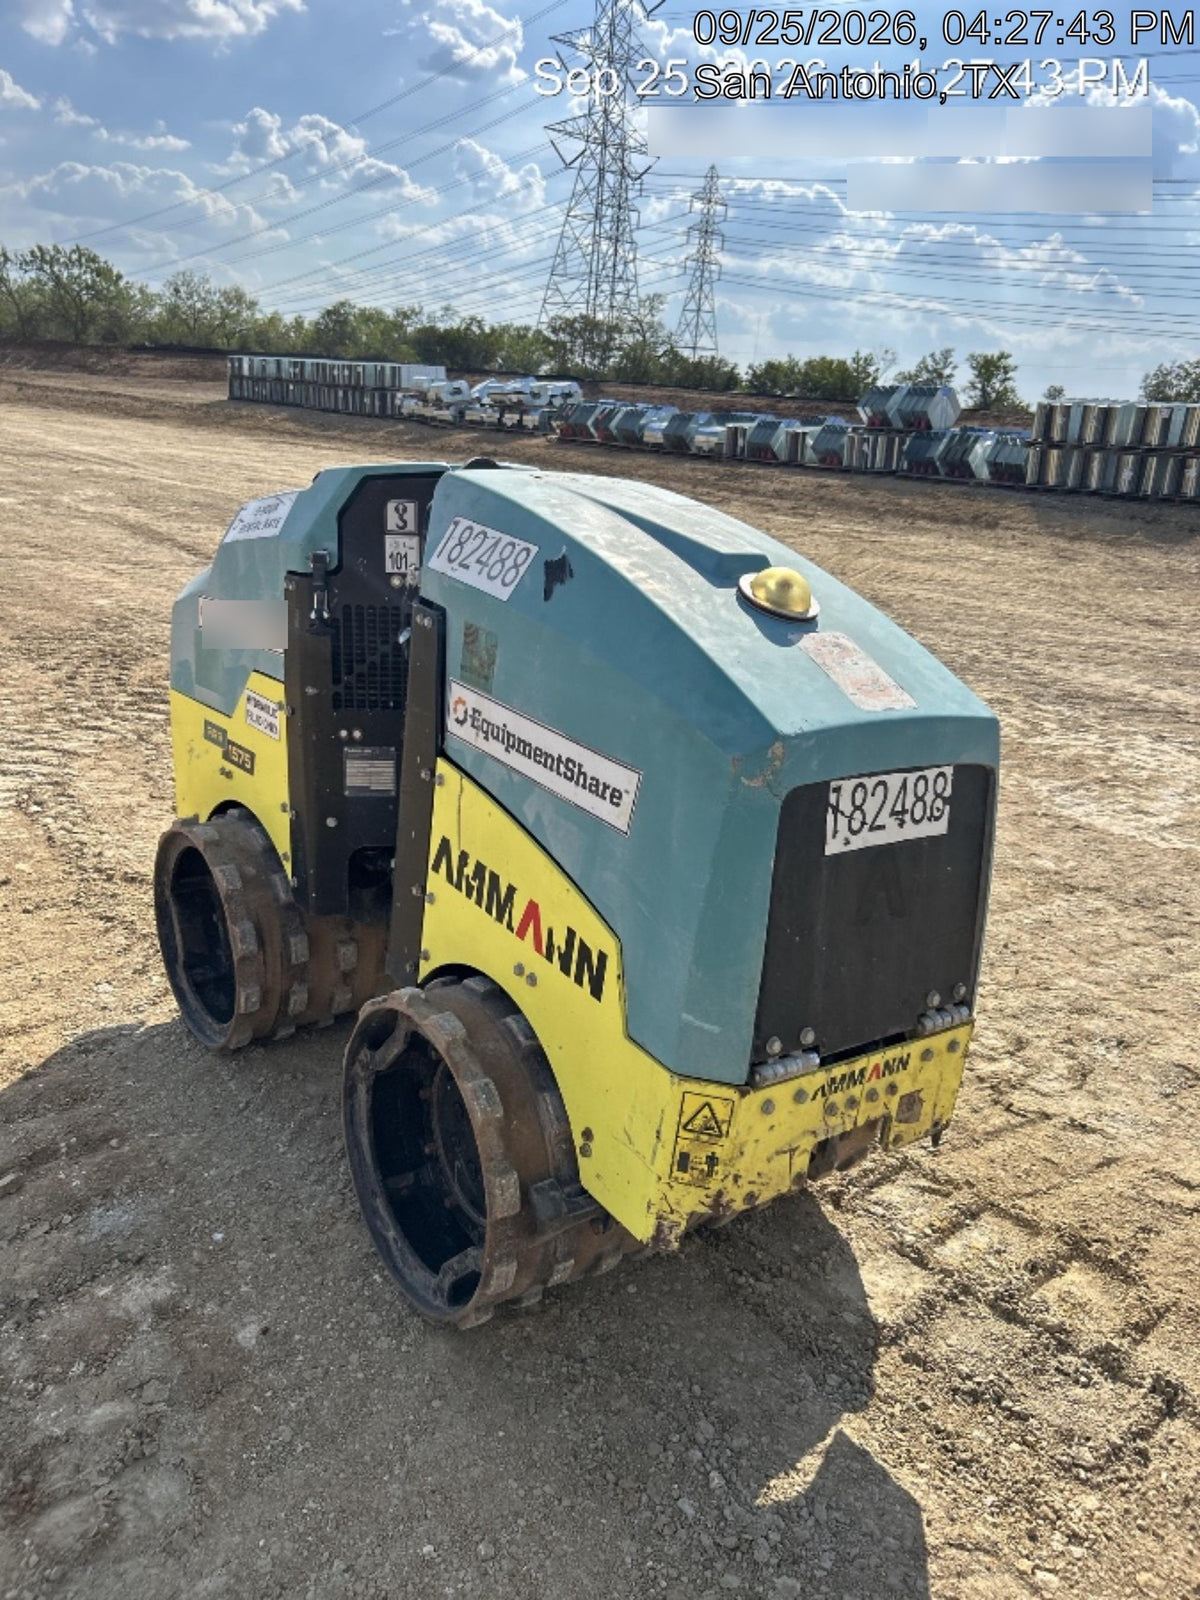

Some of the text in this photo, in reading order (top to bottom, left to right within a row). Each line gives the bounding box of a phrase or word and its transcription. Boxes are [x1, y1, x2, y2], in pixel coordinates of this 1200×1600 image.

[437, 519, 532, 588] 182488
[469, 707, 624, 808] EquipmentShare
[831, 771, 948, 840] 182488
[431, 835, 608, 1003] AMMANN
[811, 1053, 911, 1101] AMMANN
